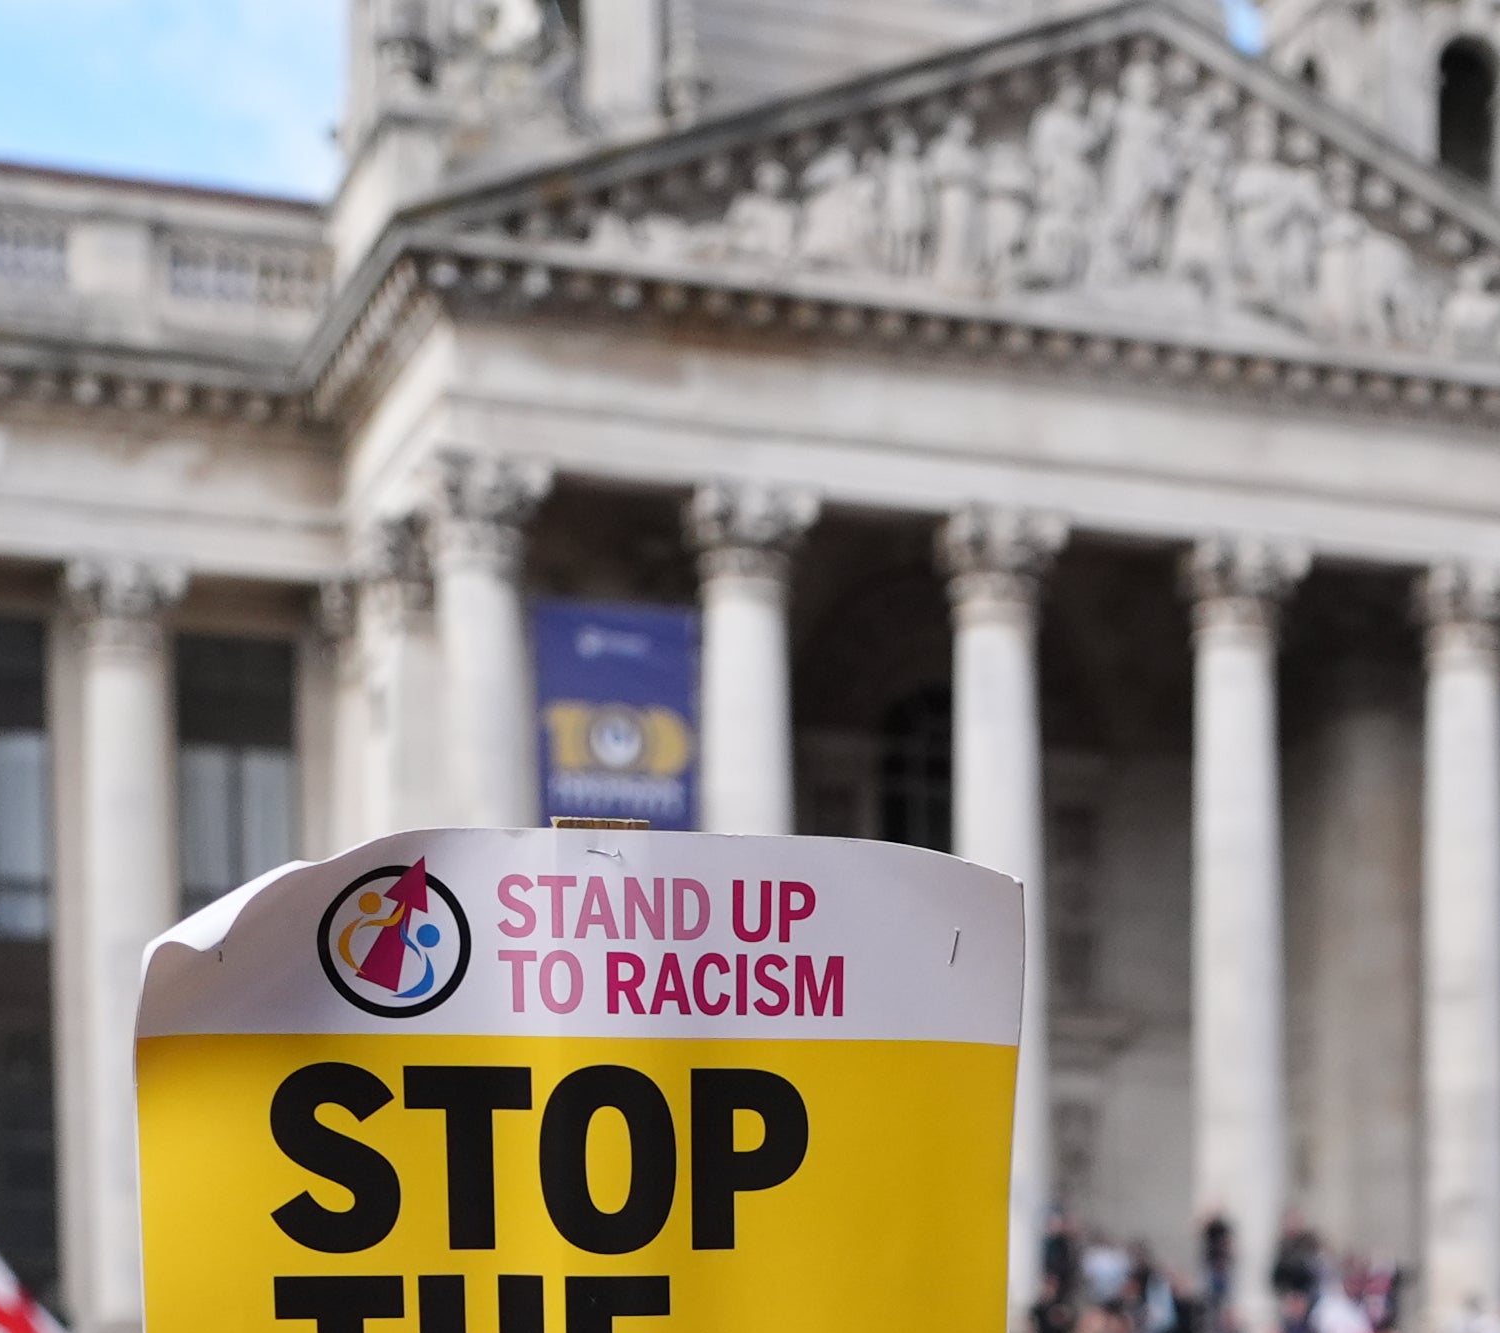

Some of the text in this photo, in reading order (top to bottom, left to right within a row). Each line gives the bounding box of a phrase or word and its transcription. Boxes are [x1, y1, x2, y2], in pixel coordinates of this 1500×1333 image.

[497, 874, 816, 944] STAND UP
[498, 948, 846, 1018] TO RACISM
[269, 1060, 809, 1256] STOP
